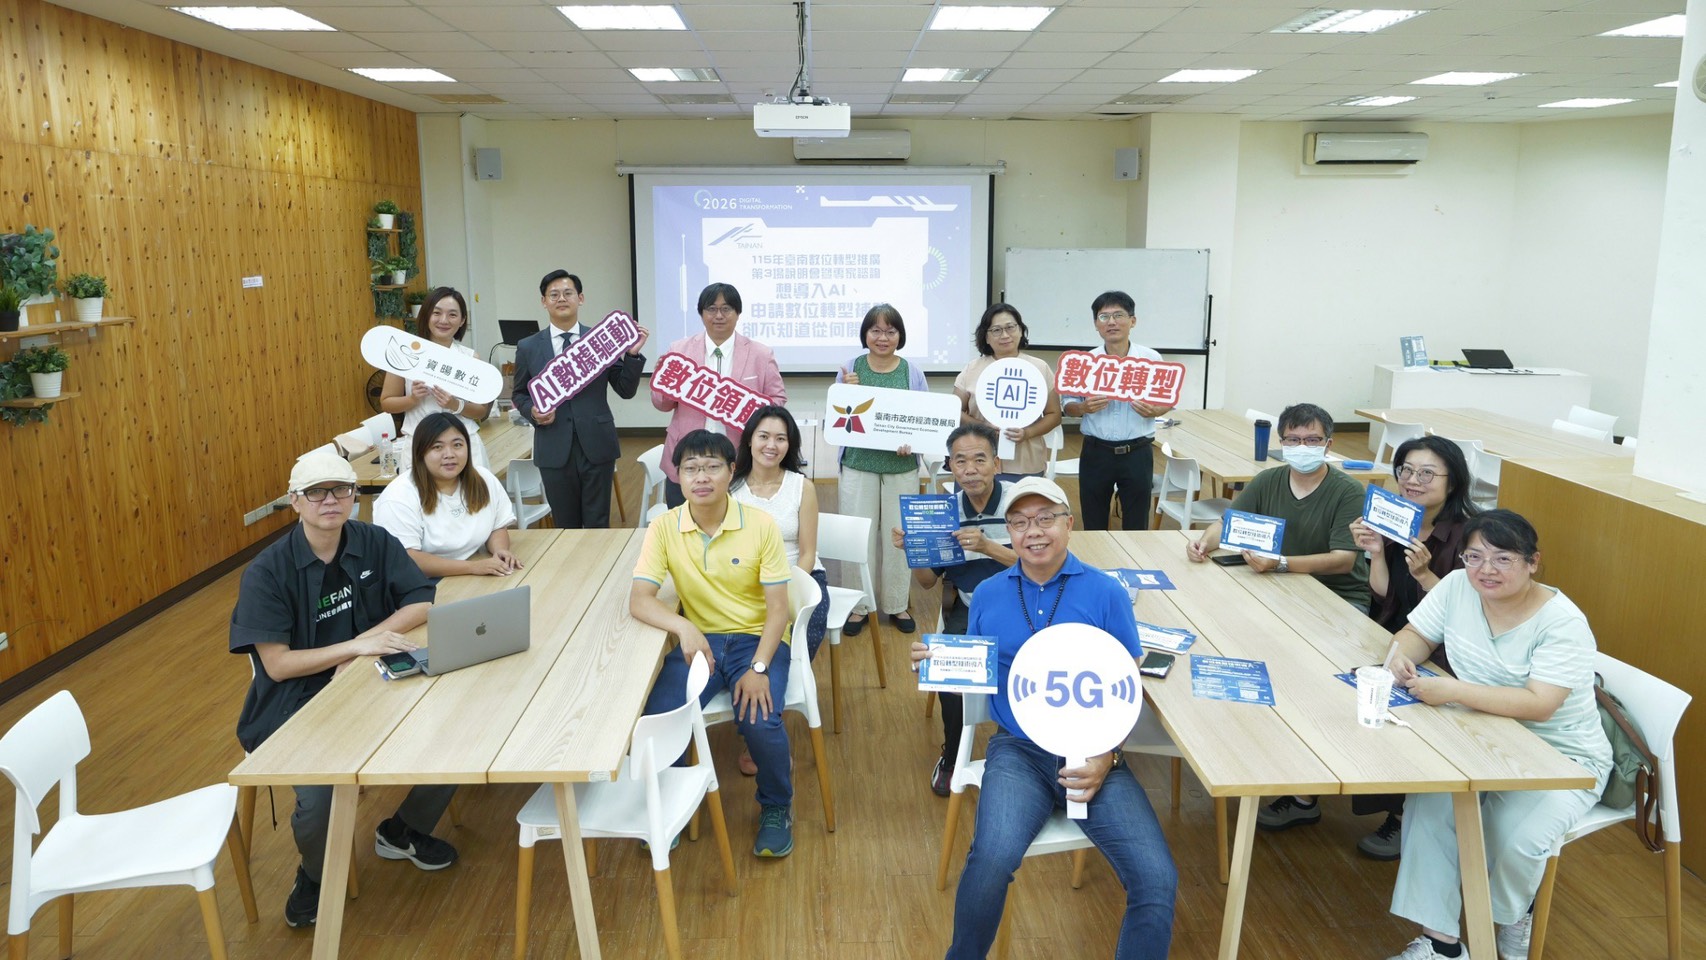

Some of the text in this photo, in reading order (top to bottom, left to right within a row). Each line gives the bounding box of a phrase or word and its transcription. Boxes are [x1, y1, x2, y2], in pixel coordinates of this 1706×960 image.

[703, 198, 737, 210] 2026
[752, 254, 880, 265] 115年臺南數位轉型推廣
[751, 303, 884, 318] 申請數位轉型補
[534, 316, 635, 409] AI數據驅動
[1062, 358, 1178, 399] 數位轉型
[1003, 384, 1020, 401] AI
[875, 412, 956, 428] 臺南市政府經濟發展局
[1045, 671, 1104, 708] 5G
